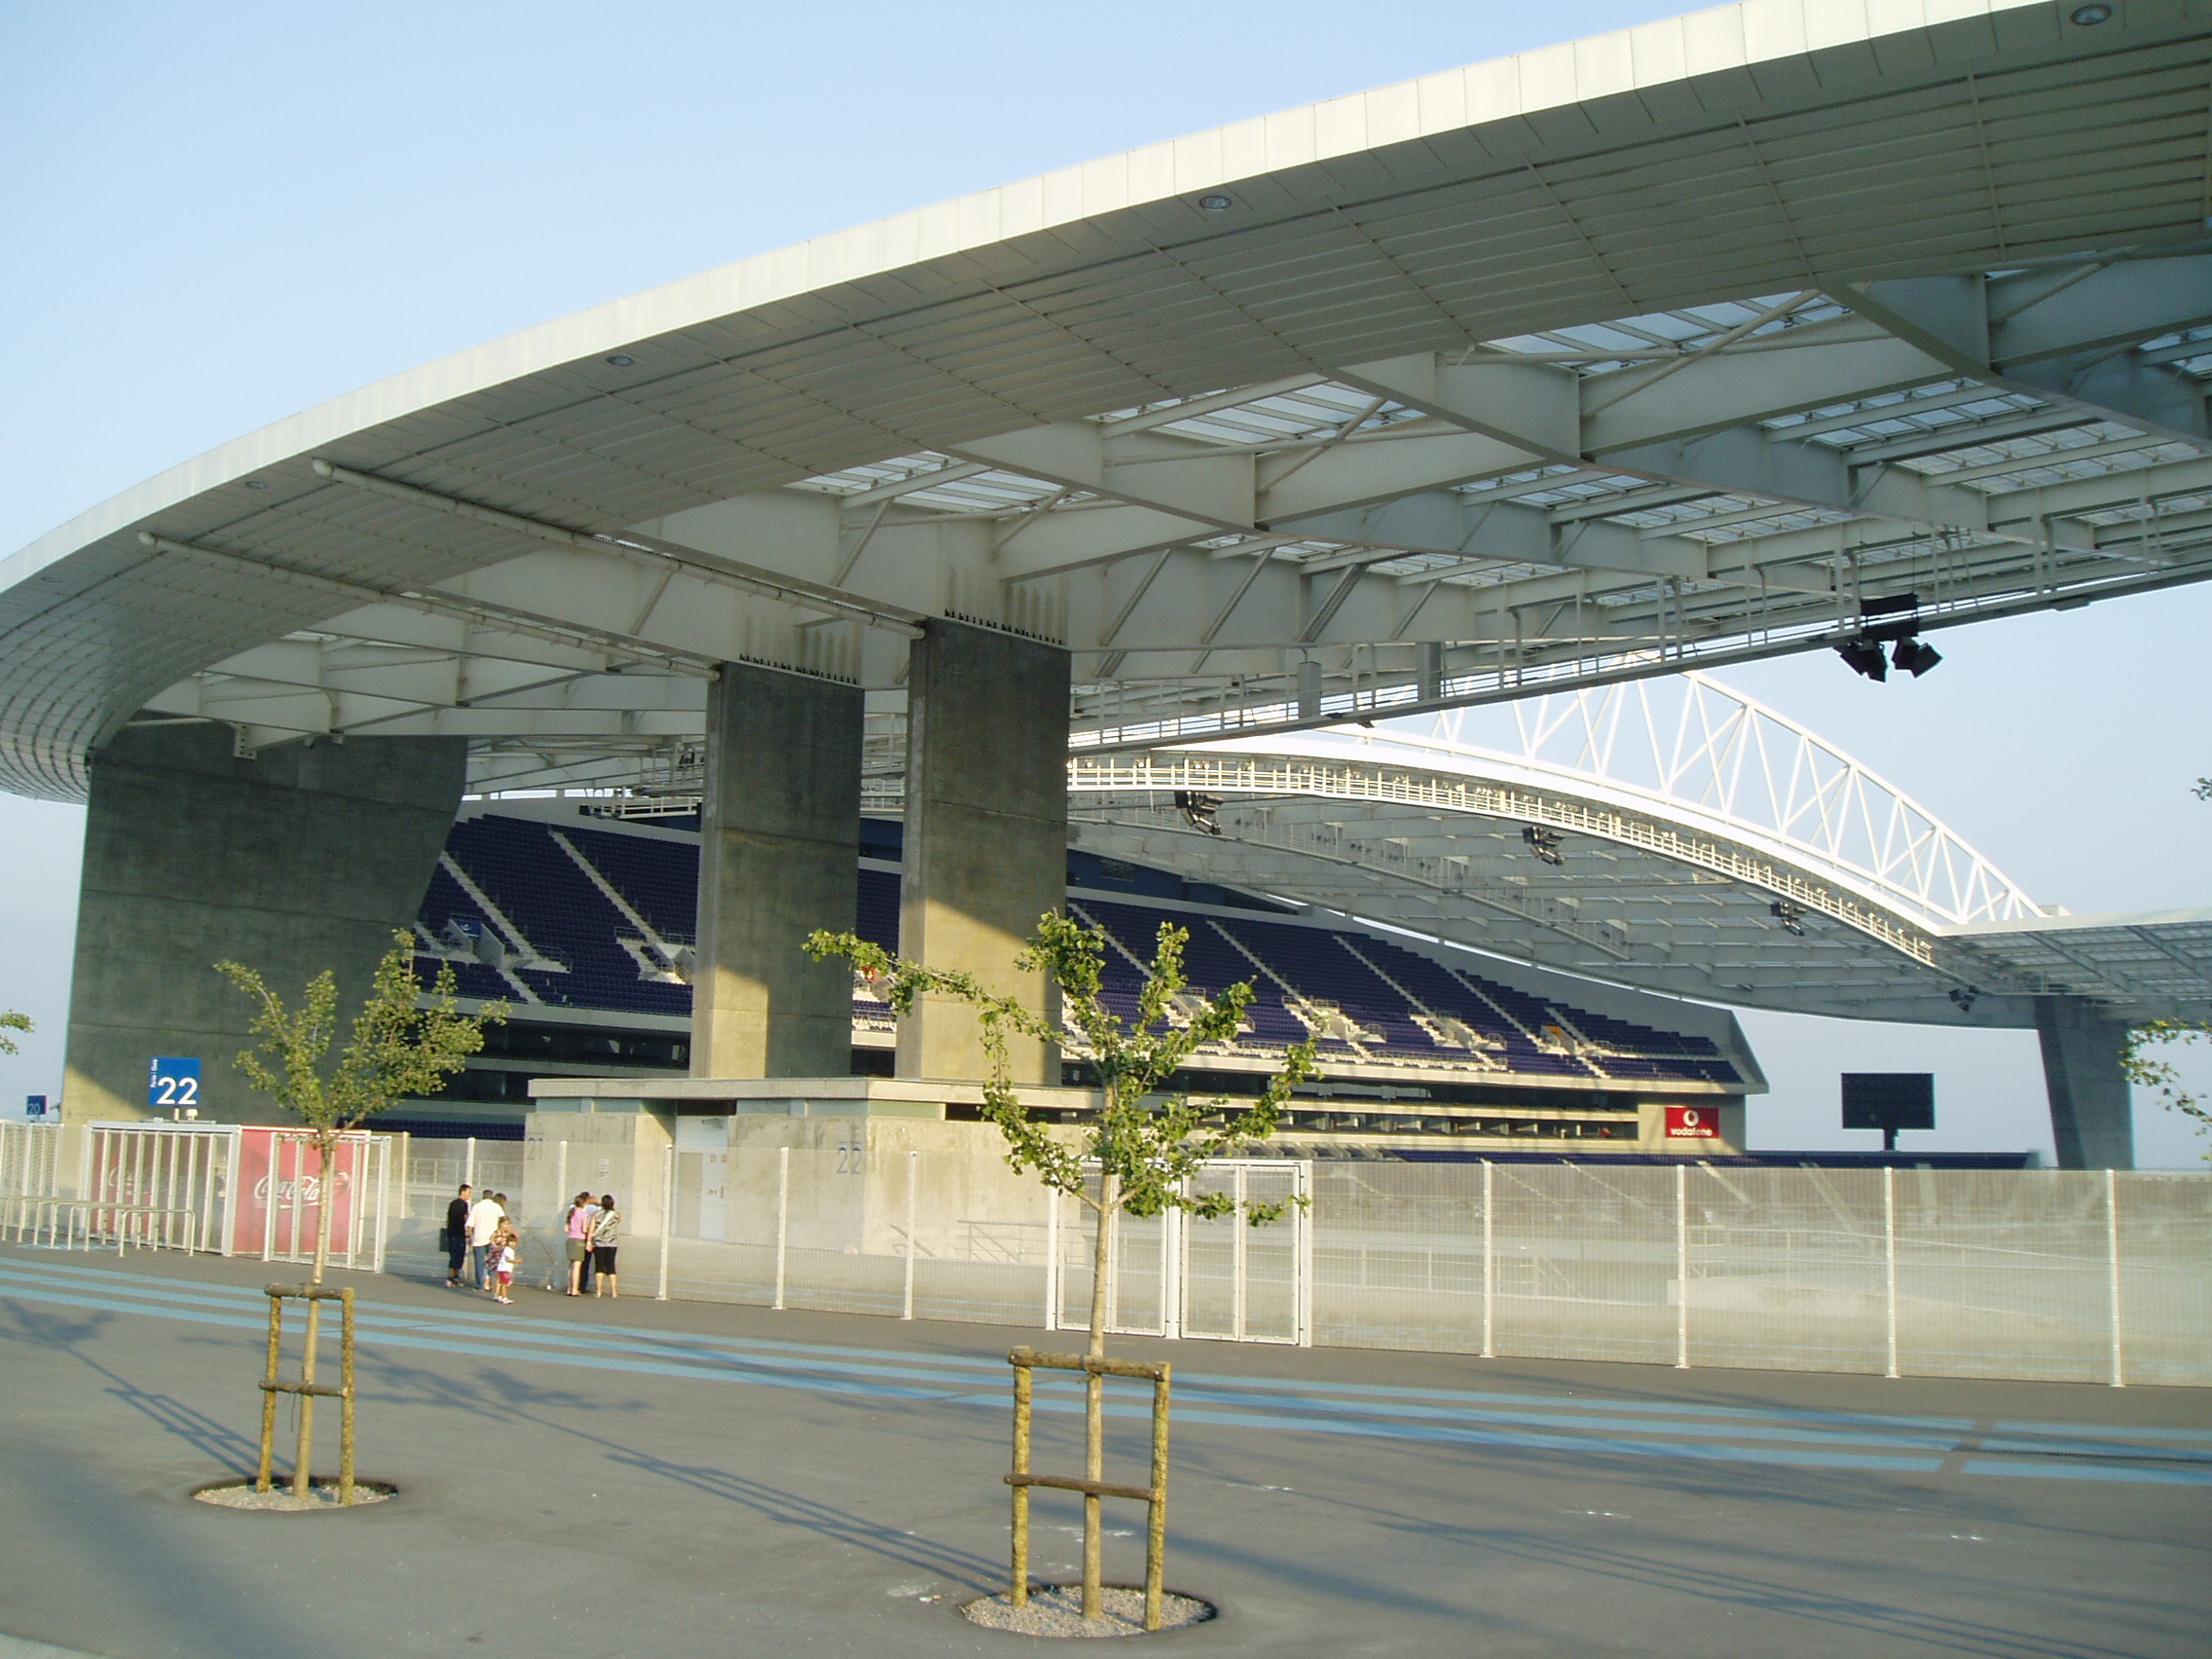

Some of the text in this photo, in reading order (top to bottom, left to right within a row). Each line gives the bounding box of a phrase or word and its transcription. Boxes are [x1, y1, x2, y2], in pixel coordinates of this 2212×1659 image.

[157, 1076, 198, 1105] 22
[1671, 1126, 1713, 1137] vodafone
[836, 1147, 863, 1174] 22
[253, 1173, 321, 1201] Coa-Cla
